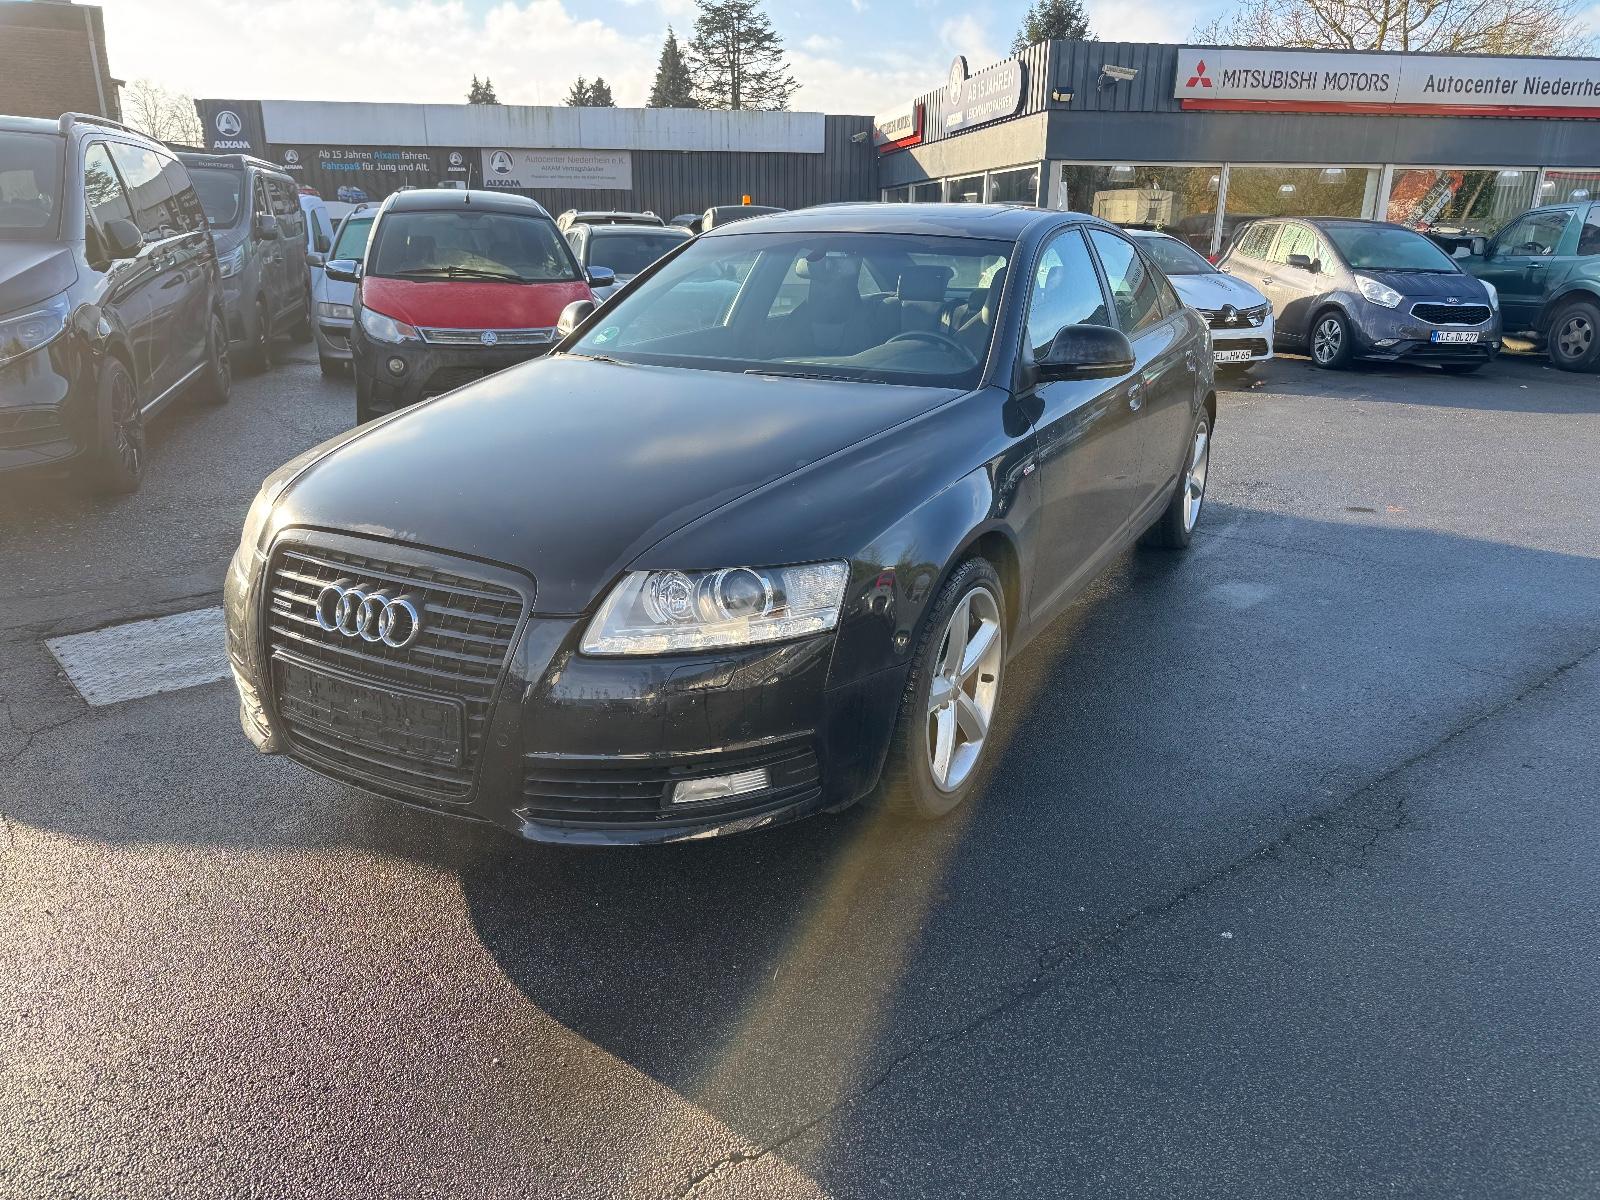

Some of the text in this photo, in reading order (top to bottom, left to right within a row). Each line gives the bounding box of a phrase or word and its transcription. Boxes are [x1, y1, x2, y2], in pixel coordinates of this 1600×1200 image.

[985, 66, 1014, 97] JAHREN
[1222, 69, 1390, 92] MITSUBISHI MOTORS
[1423, 74, 1518, 95] Autocenter
[213, 140, 251, 149] AIXAM
[318, 150, 431, 160] Ab 15 Jahren Aixam fahren.
[525, 155, 565, 163] Autocenter
[567, 155, 610, 164] Niederrhein
[321, 161, 430, 173] Fahrspaß für Jung und Alt.
[485, 179, 521, 187] AIXAM
[1437, 332, 1478, 341] KLE DL 277
[1230, 351, 1241, 361] HW
[1241, 351, 1250, 360] 65
